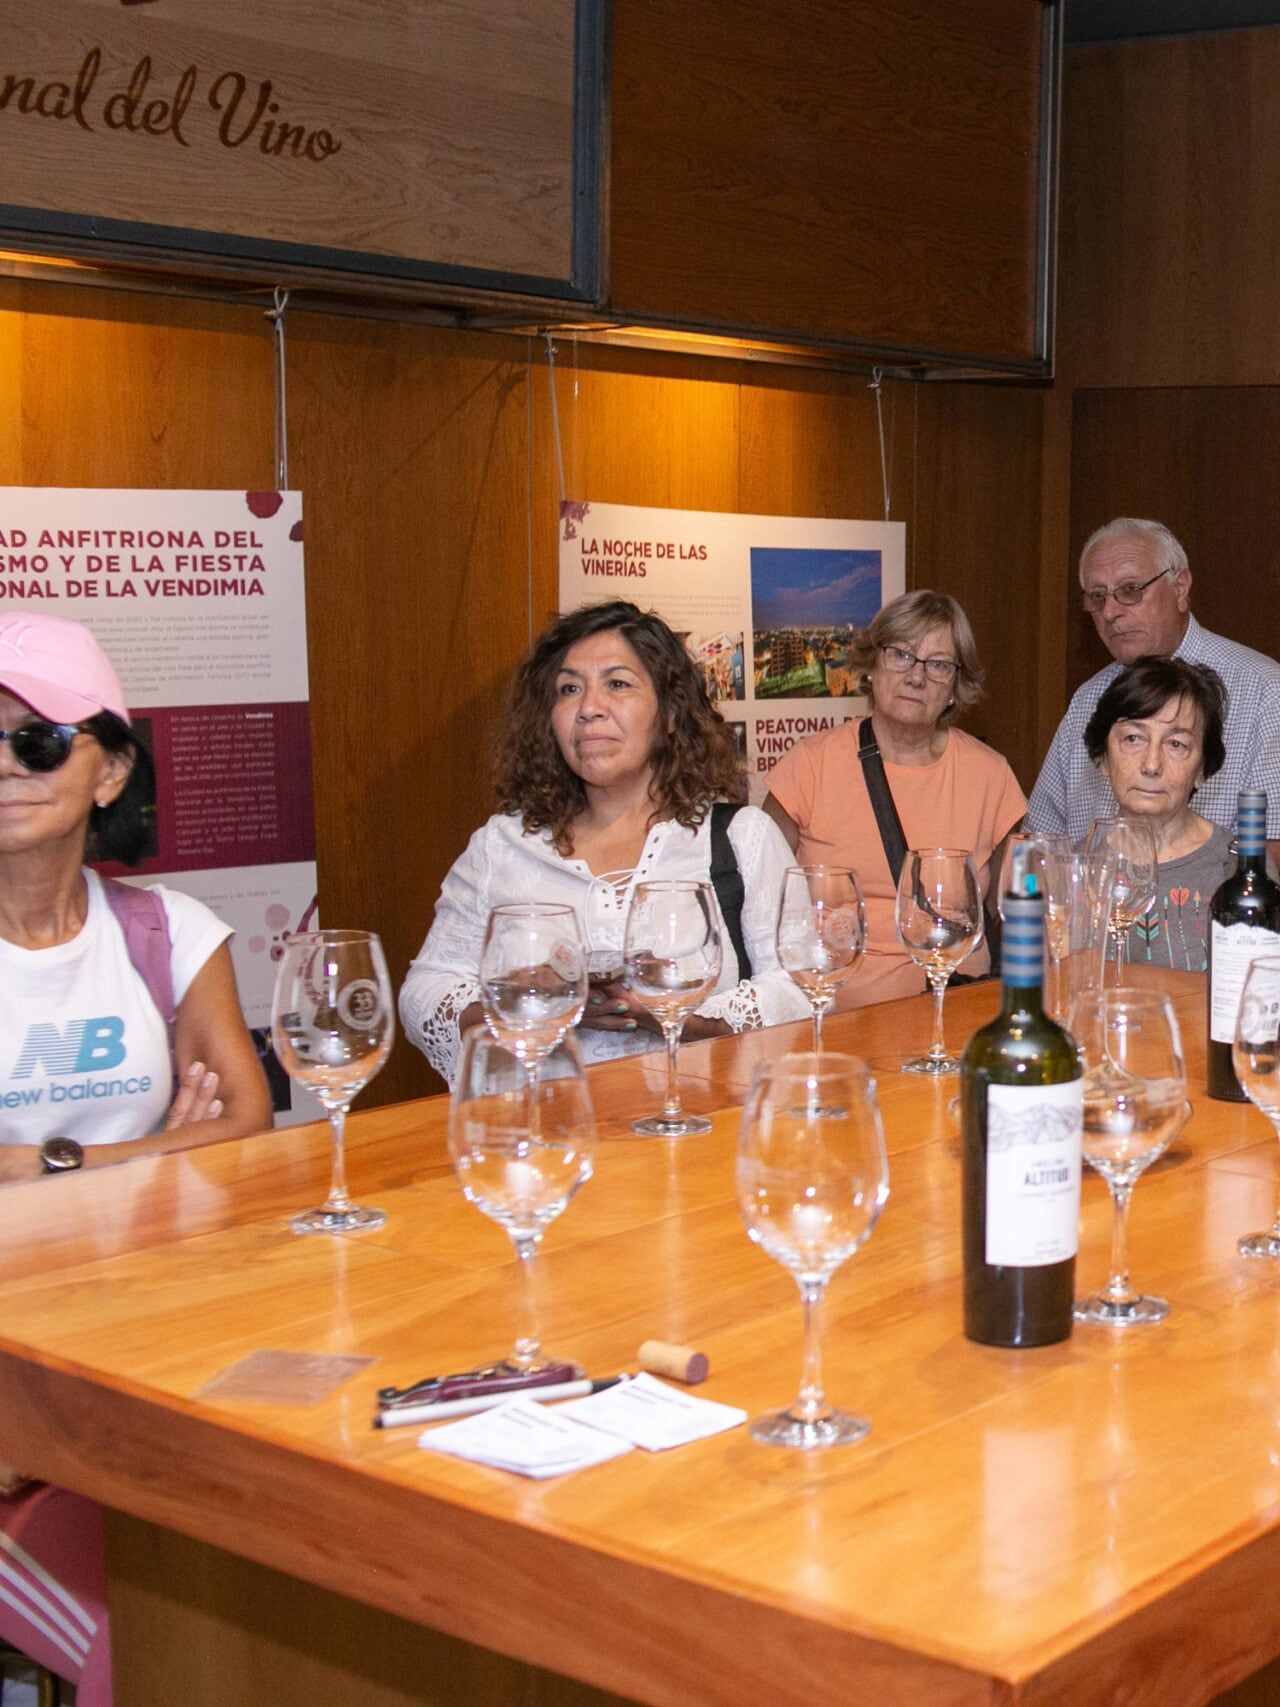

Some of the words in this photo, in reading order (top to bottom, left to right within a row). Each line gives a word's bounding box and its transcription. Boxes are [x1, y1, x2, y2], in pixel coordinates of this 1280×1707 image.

[0, 47, 101, 132] nal
[104, 55, 197, 148] del
[208, 71, 342, 163] Vino
[37, 530, 205, 548] ANFITRIONA
[214, 531, 263, 548] DEL
[581, 538, 599, 555] LA
[603, 539, 652, 558] NOCHE
[656, 543, 675, 559] DE
[679, 544, 708, 561] LAS
[59, 555, 75, 573] Y
[86, 555, 120, 573] DE
[131, 555, 165, 573] LA
[175, 554, 266, 572] FIESTA
[581, 556, 647, 578] VINERÍAS
[66, 580, 98, 598] DE
[105, 580, 138, 598] LA
[144, 579, 265, 597] VENDIMIA
[757, 755, 783, 772] BR
[9, 1015, 127, 1080] NB
[0, 1087, 44, 1110] ew
[50, 1076, 152, 1102] balance
